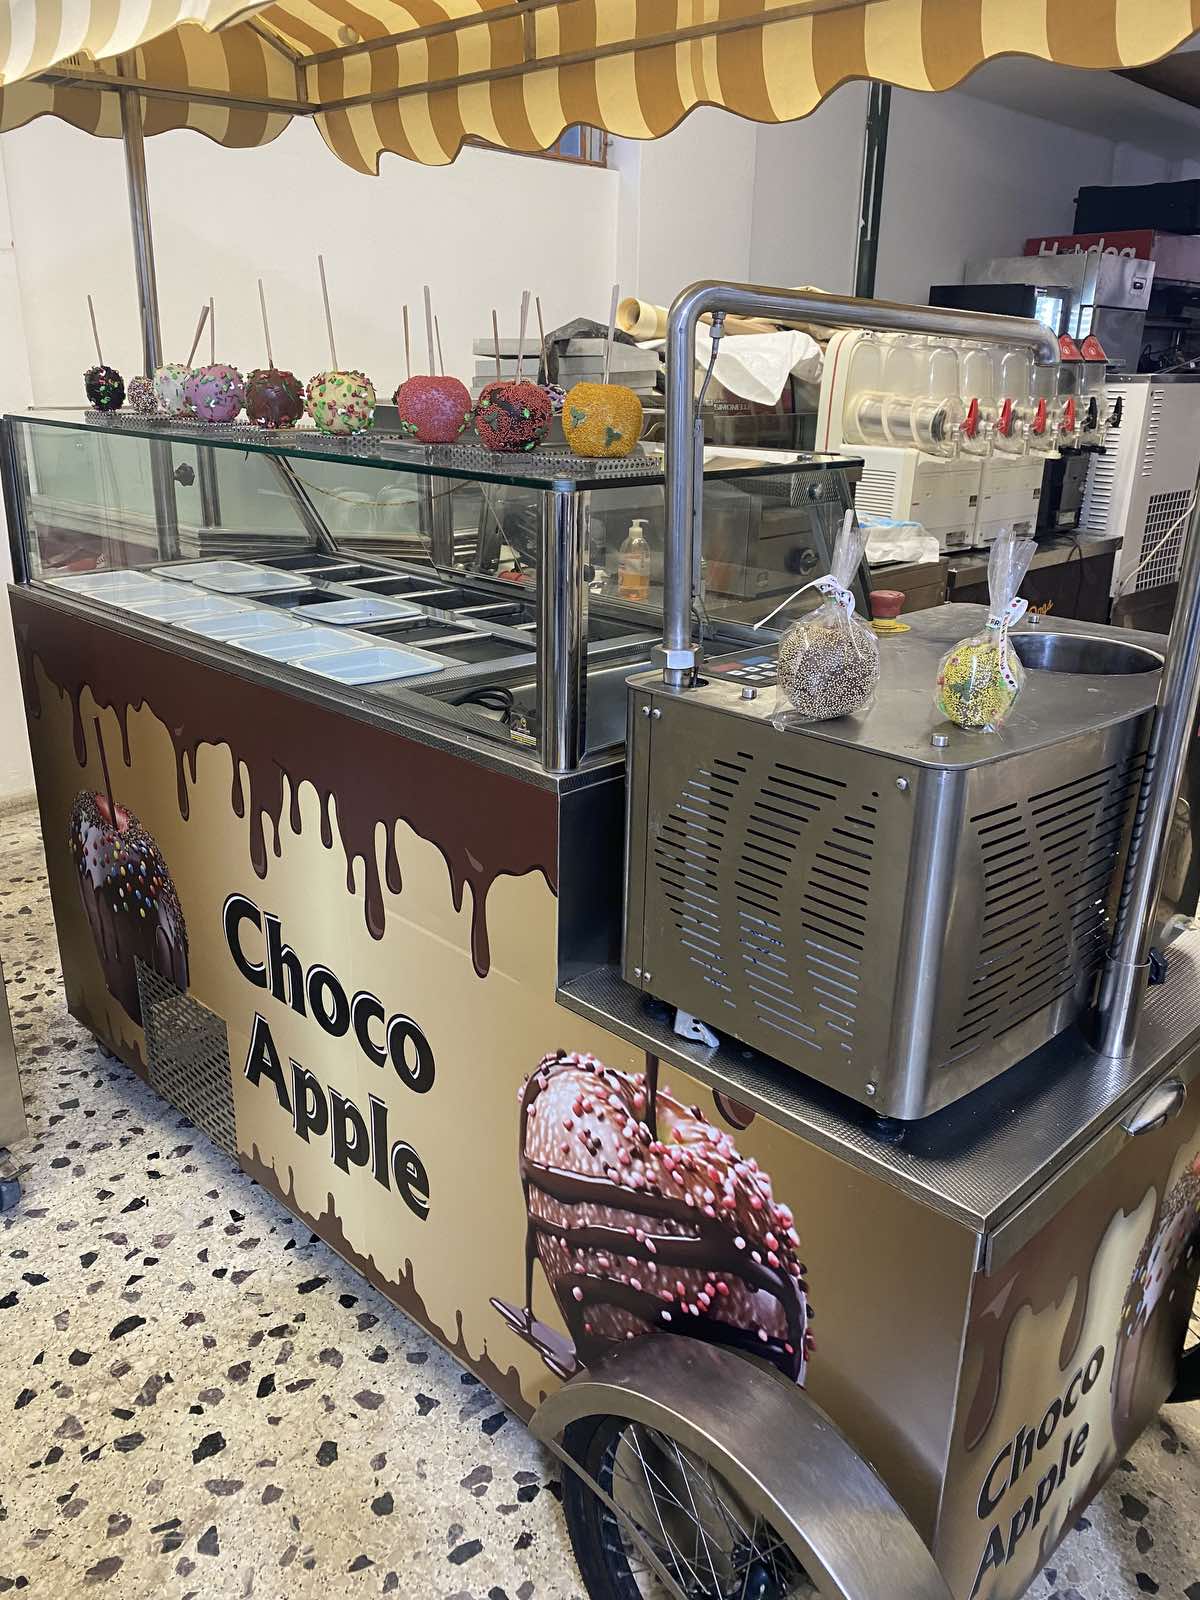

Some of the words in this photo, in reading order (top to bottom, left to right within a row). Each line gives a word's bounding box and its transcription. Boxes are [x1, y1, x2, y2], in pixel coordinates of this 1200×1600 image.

[222, 892, 436, 1094] Choco
[243, 1011, 431, 1222] Apple
[967, 1422, 1090, 1600] Apple
[976, 1344, 1105, 1520] Choco
